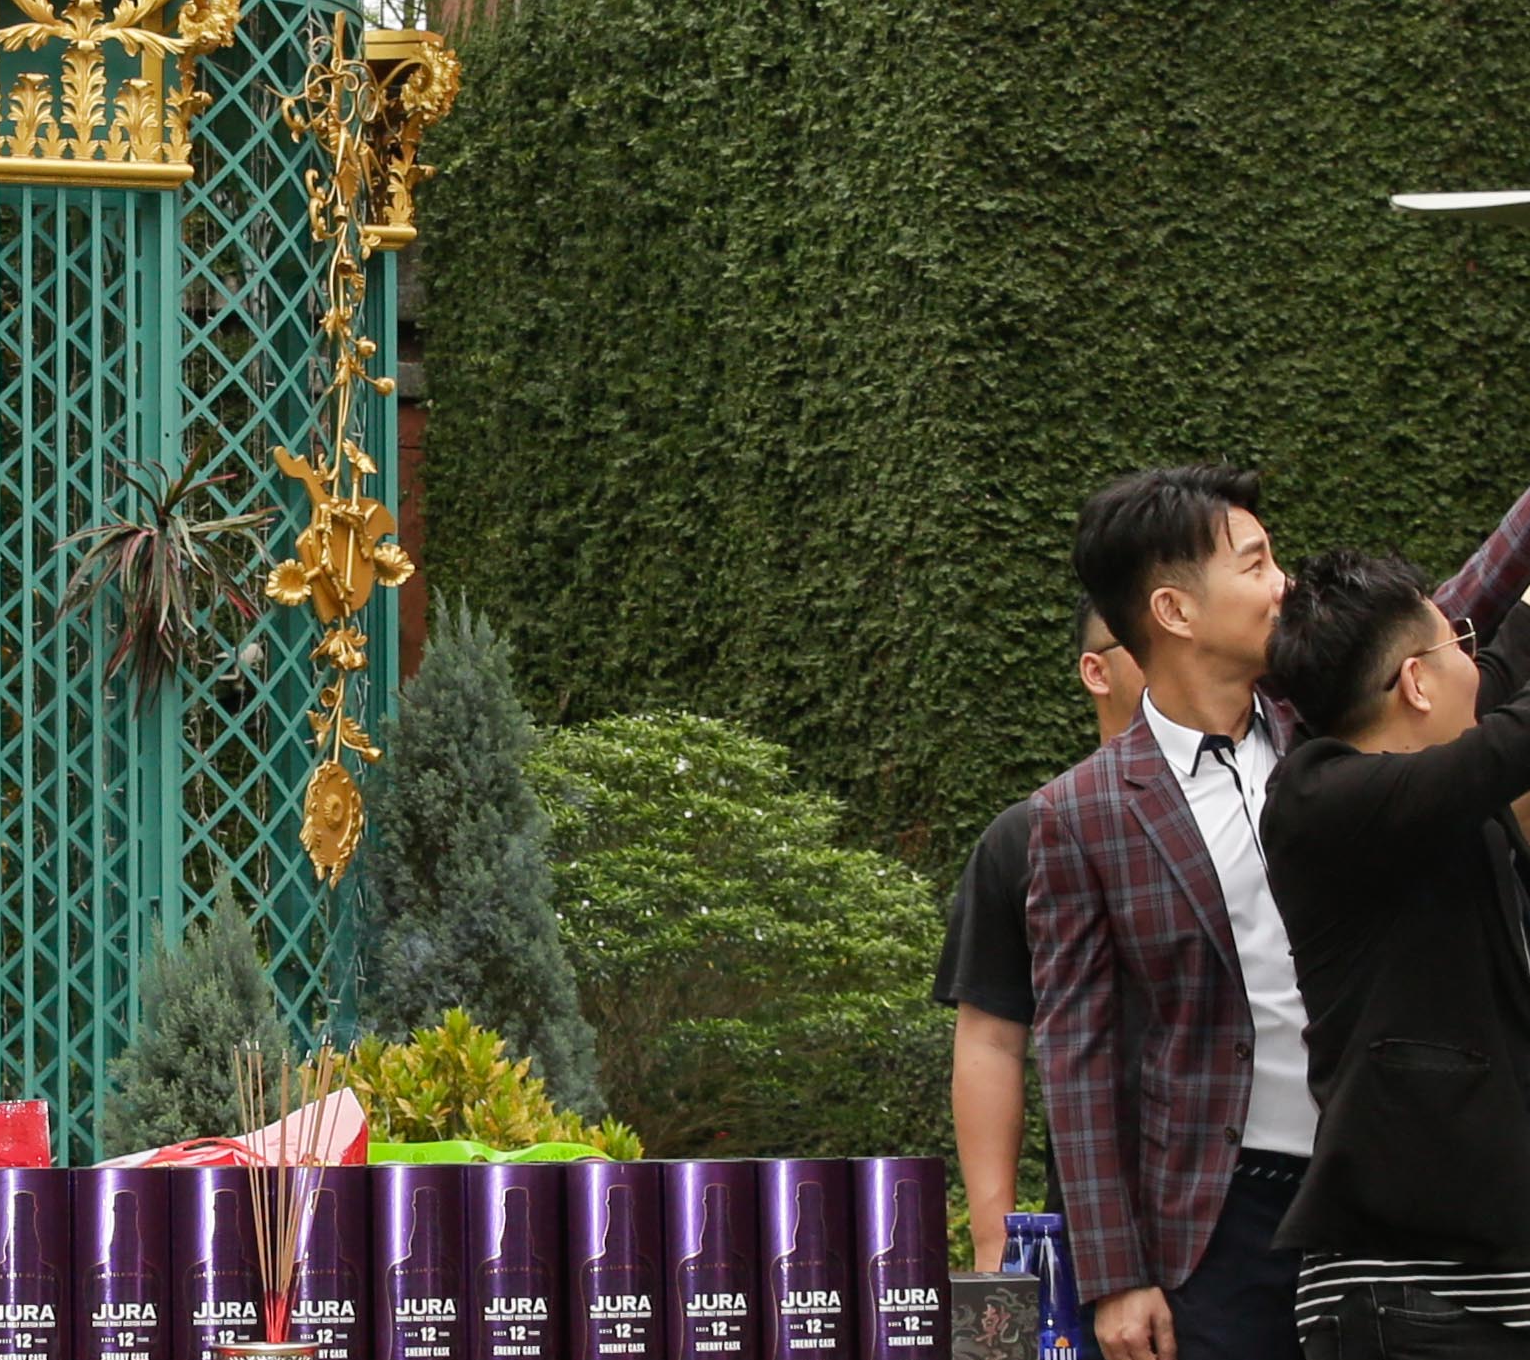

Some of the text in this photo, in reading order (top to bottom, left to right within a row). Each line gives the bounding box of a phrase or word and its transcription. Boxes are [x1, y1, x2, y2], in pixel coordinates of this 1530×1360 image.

[589, 1294, 652, 1312] JURA
[686, 1293, 747, 1310] JURA
[780, 1291, 841, 1308] JURA
[878, 1287, 939, 1305] JURA
[91, 1303, 157, 1320] JURA
[192, 1301, 258, 1319] JURA
[290, 1299, 355, 1317] JURA
[395, 1297, 457, 1315] JURA
[483, 1297, 548, 1314] JURA
[614, 1323, 631, 1338] 12
[710, 1321, 727, 1336] 12
[804, 1319, 821, 1334] 12
[903, 1316, 919, 1331] 12
[14, 1333, 33, 1348] 12
[116, 1332, 135, 1348] 12
[216, 1330, 235, 1345] 12
[315, 1328, 333, 1344] 12
[419, 1326, 436, 1341] 12
[508, 1325, 526, 1341] 12
[915, 1335, 934, 1346] CASK
[521, 1345, 541, 1356] CASK
[627, 1342, 646, 1353] CASK
[723, 1341, 741, 1352] CASK
[817, 1338, 836, 1349] CASK
[432, 1346, 451, 1357] CASK
